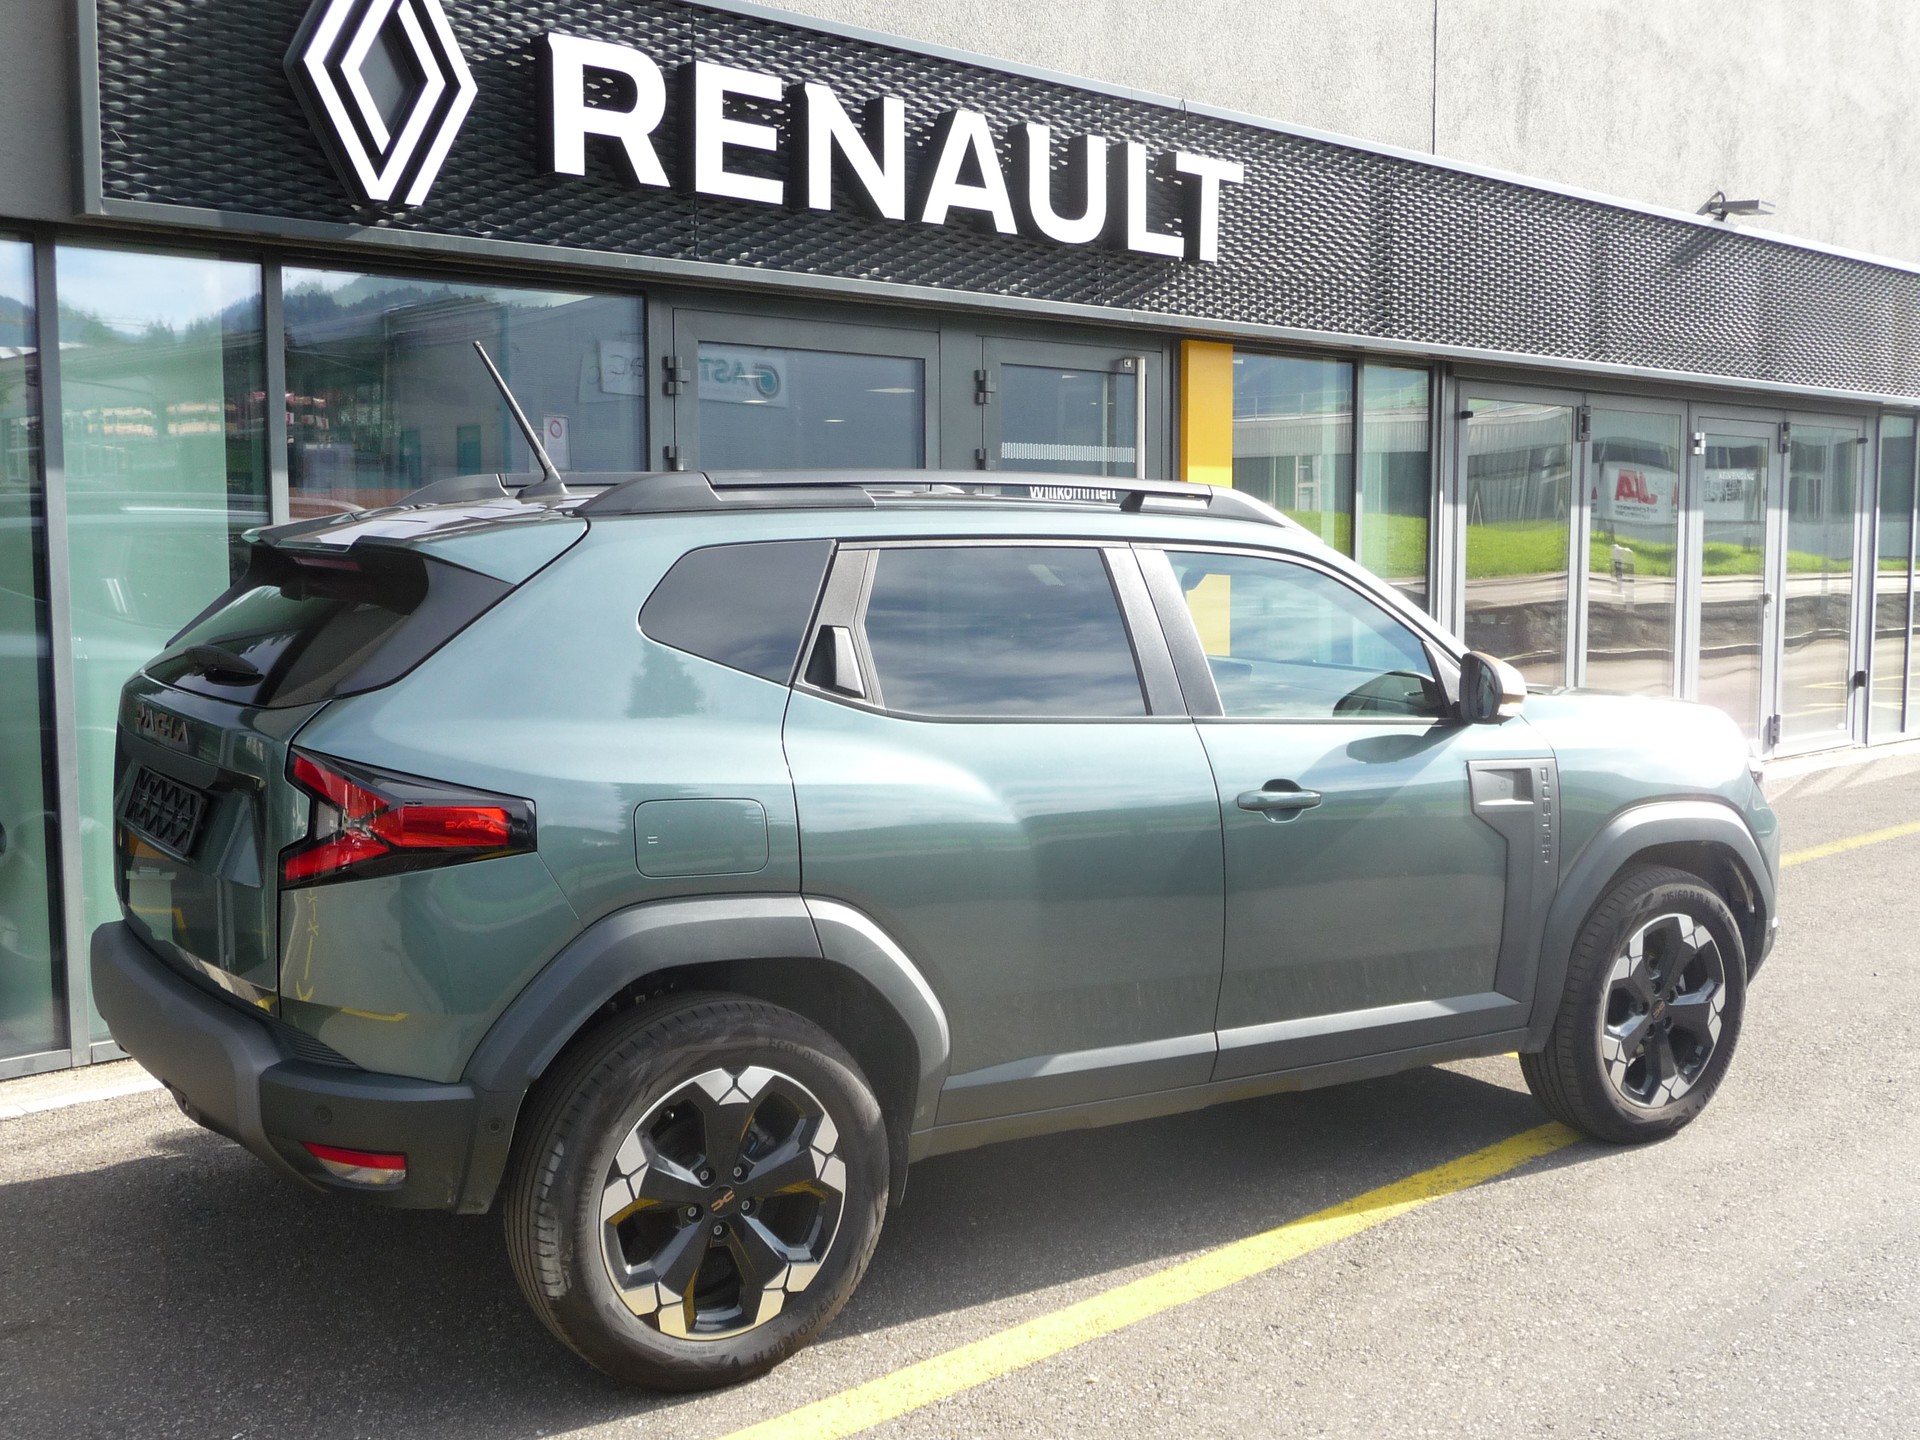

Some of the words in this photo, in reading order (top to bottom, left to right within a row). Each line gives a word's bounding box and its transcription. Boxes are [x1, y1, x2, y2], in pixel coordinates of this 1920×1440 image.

[547, 32, 1245, 262] RENAULT
[1029, 486, 1117, 500] Willkommen
[1539, 767, 1552, 863] DUSTER
